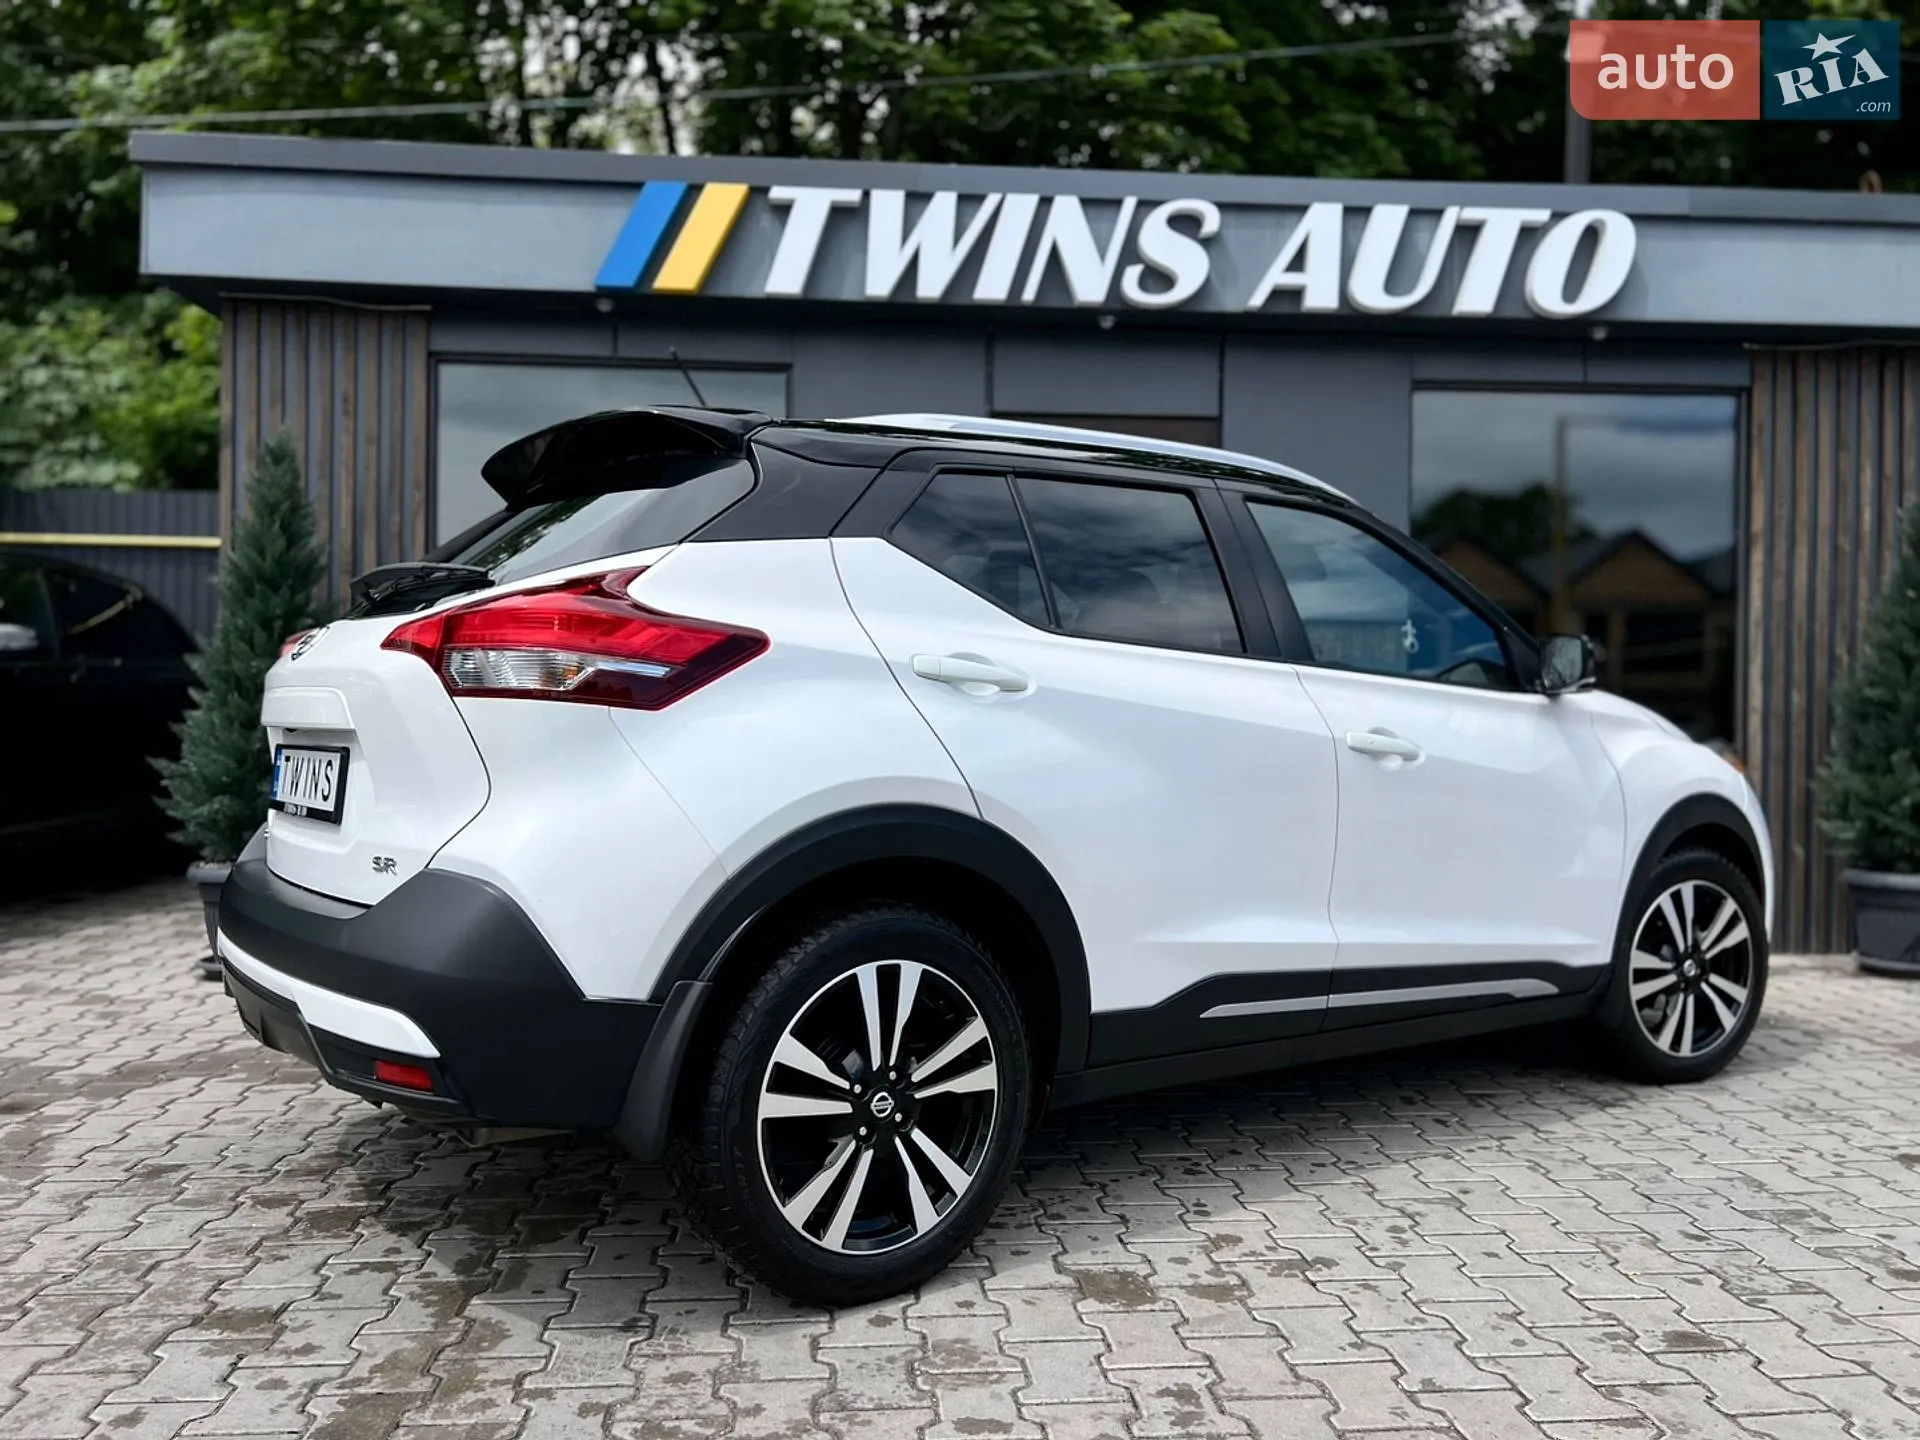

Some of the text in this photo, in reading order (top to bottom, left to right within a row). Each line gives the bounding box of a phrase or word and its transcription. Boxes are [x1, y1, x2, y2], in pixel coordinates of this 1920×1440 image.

[764, 186, 1637, 318] TWINS AUTO
[282, 755, 333, 802] TWINS
[372, 856, 397, 876] SR
